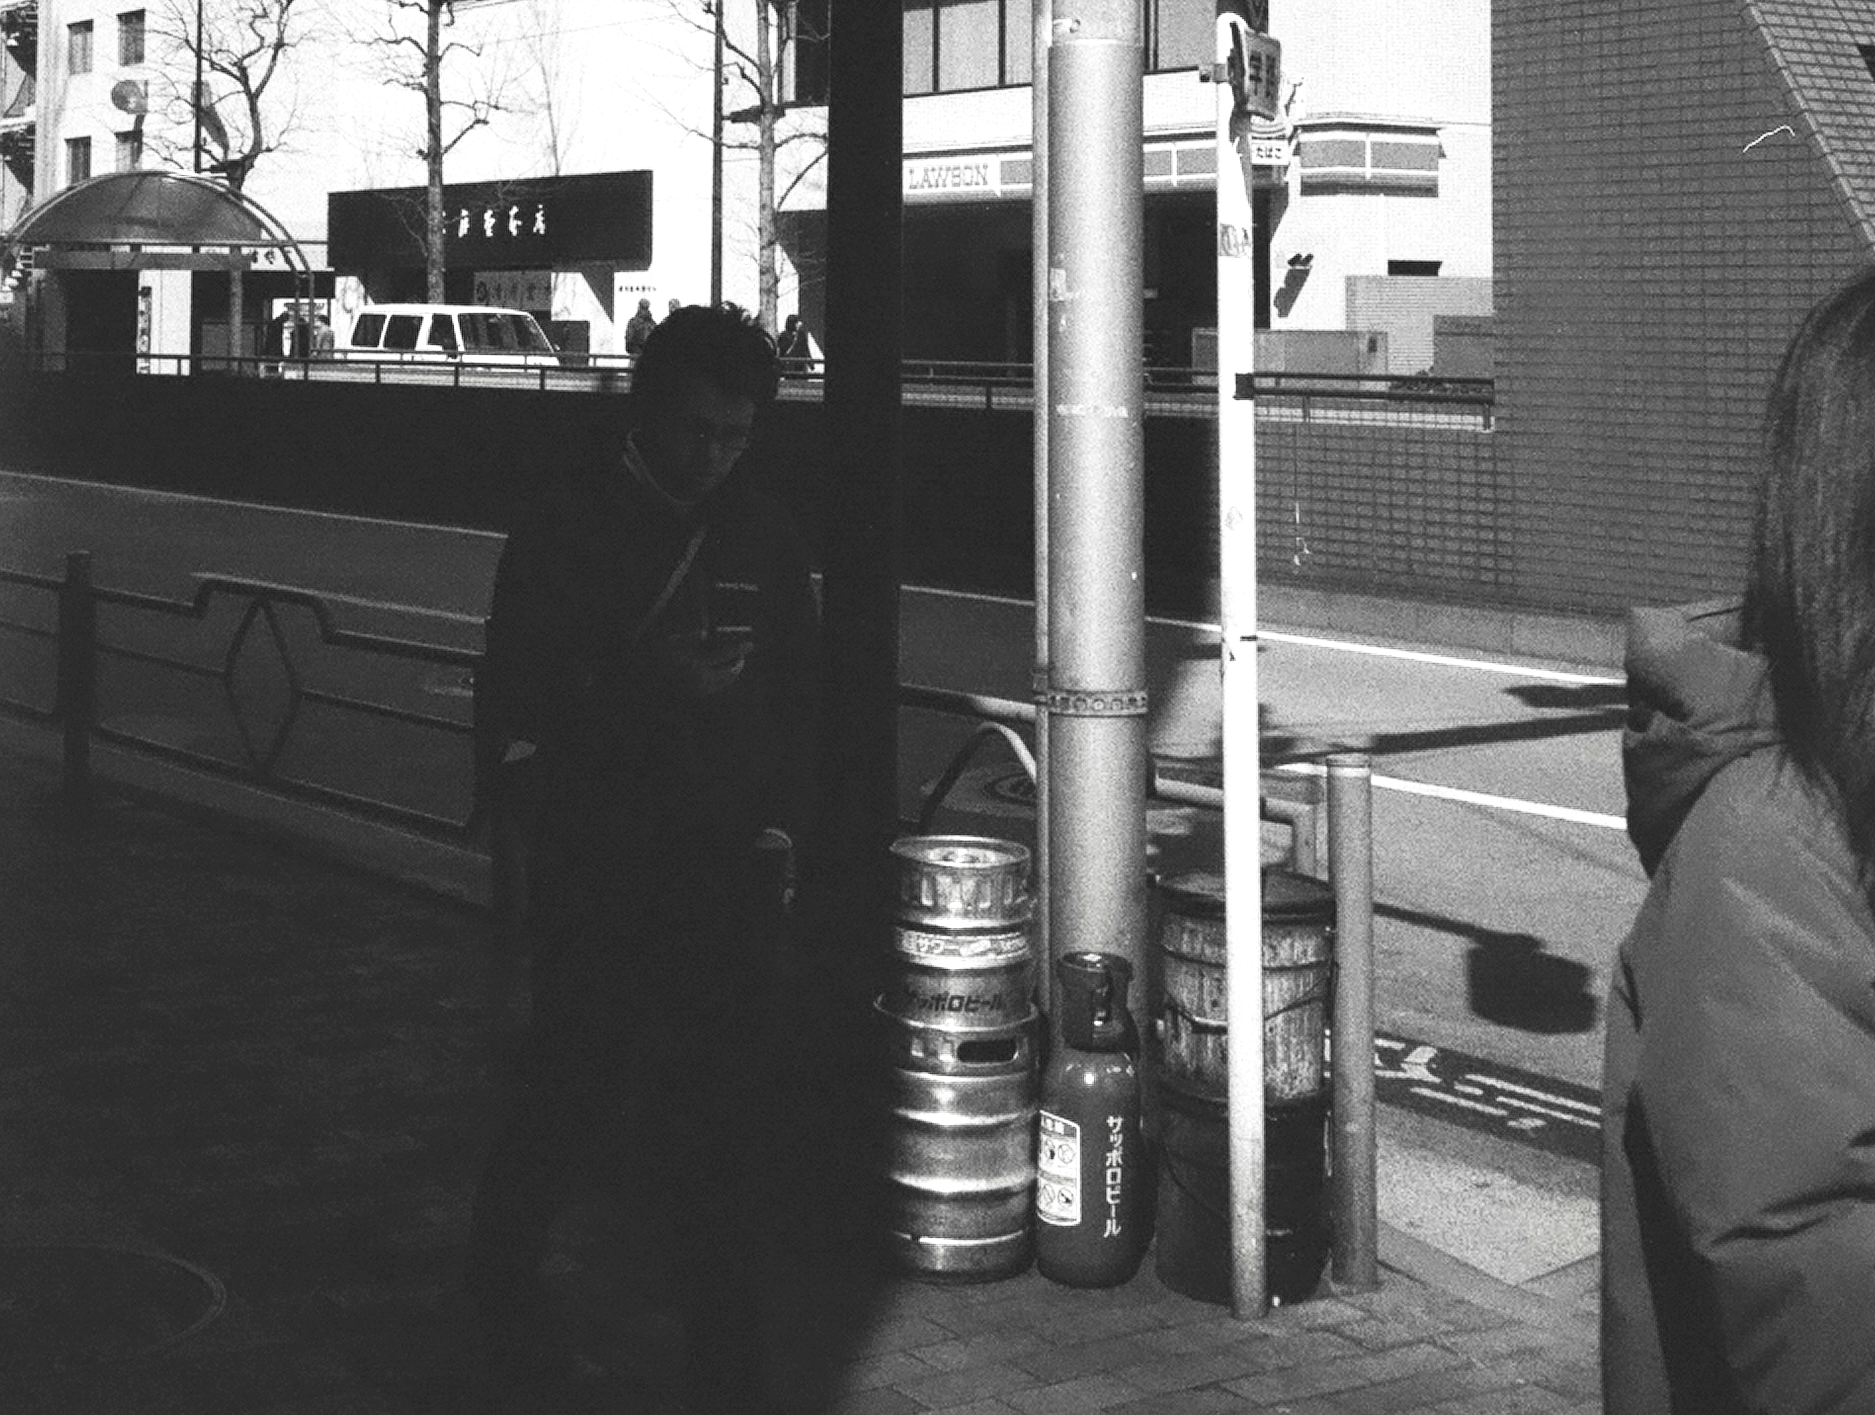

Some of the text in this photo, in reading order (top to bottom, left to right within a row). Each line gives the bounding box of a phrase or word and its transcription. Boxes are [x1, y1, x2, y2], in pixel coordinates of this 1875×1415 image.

[908, 164, 988, 190] LAWSON
[1103, 1114, 1124, 1239] サッポロビール
